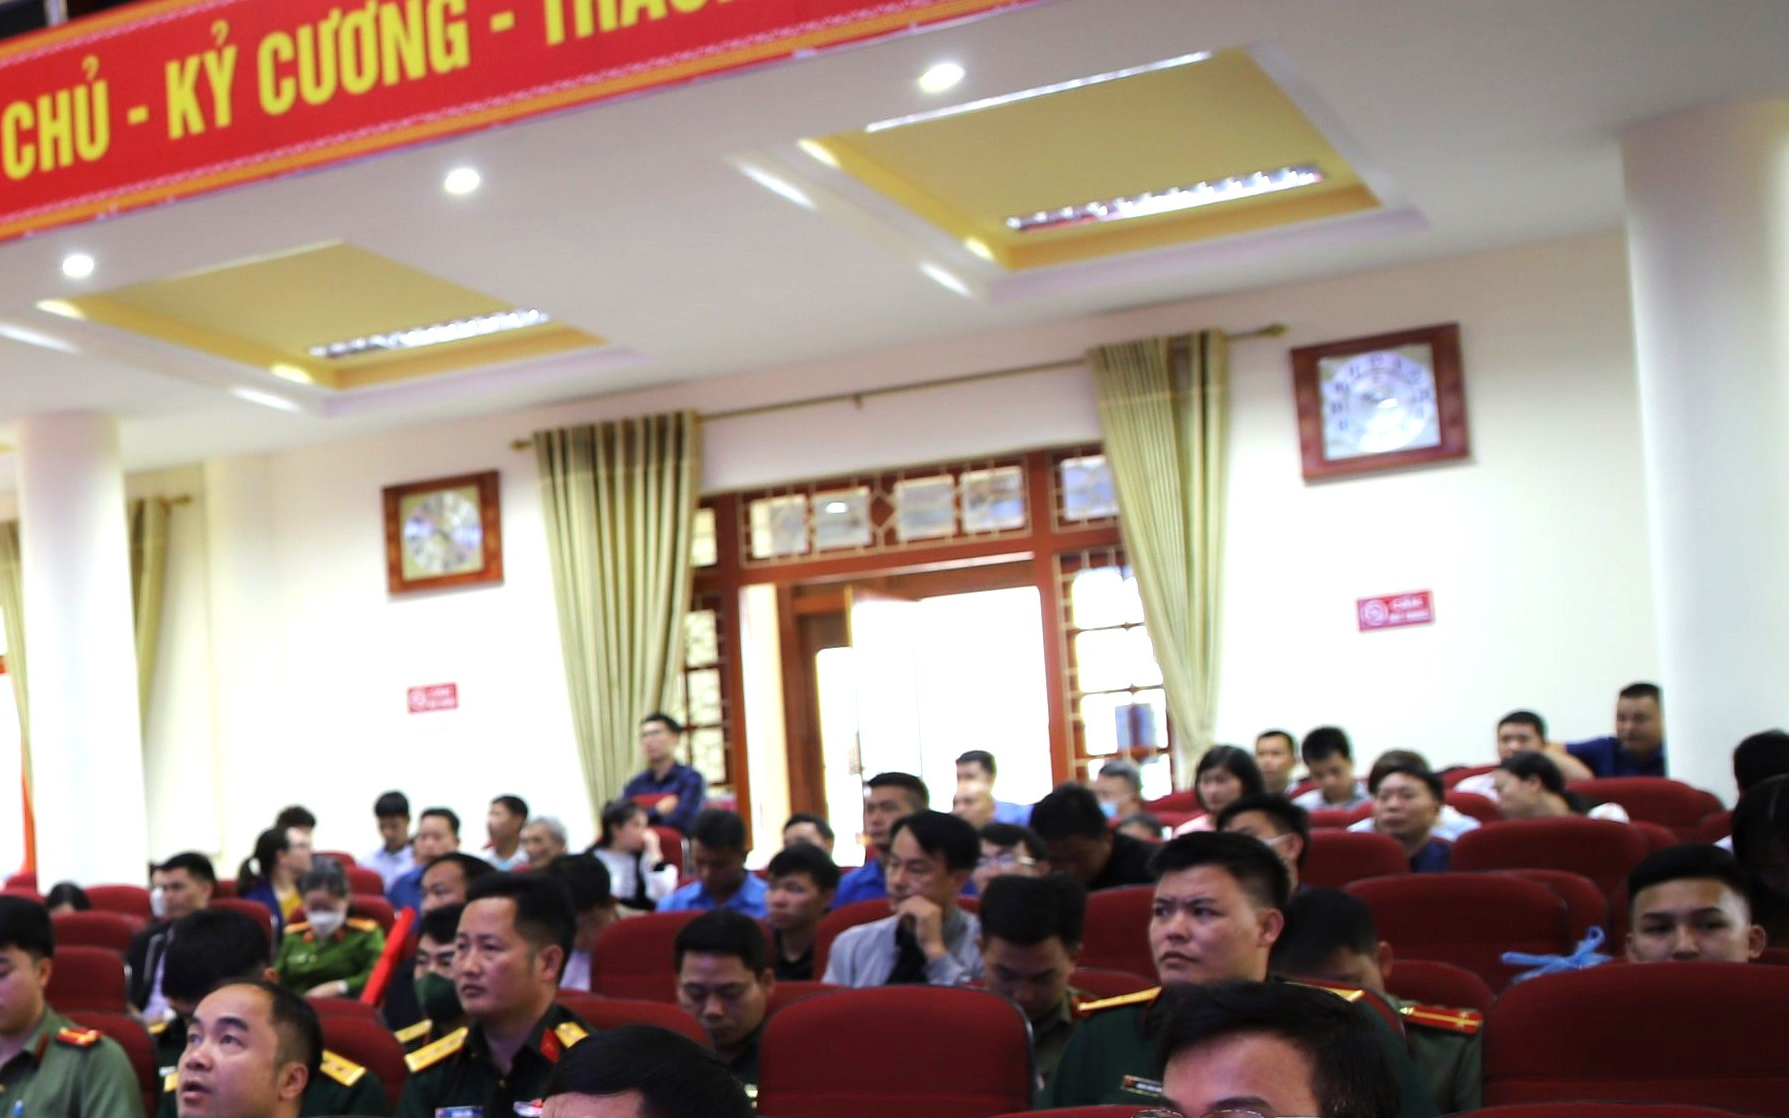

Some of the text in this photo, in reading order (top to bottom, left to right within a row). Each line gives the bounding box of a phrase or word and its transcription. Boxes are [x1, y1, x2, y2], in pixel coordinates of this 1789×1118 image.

[1, 56, 110, 180] CHỦ
[165, 20, 238, 140] KỶ
[257, 0, 470, 116] CƯƠNG
